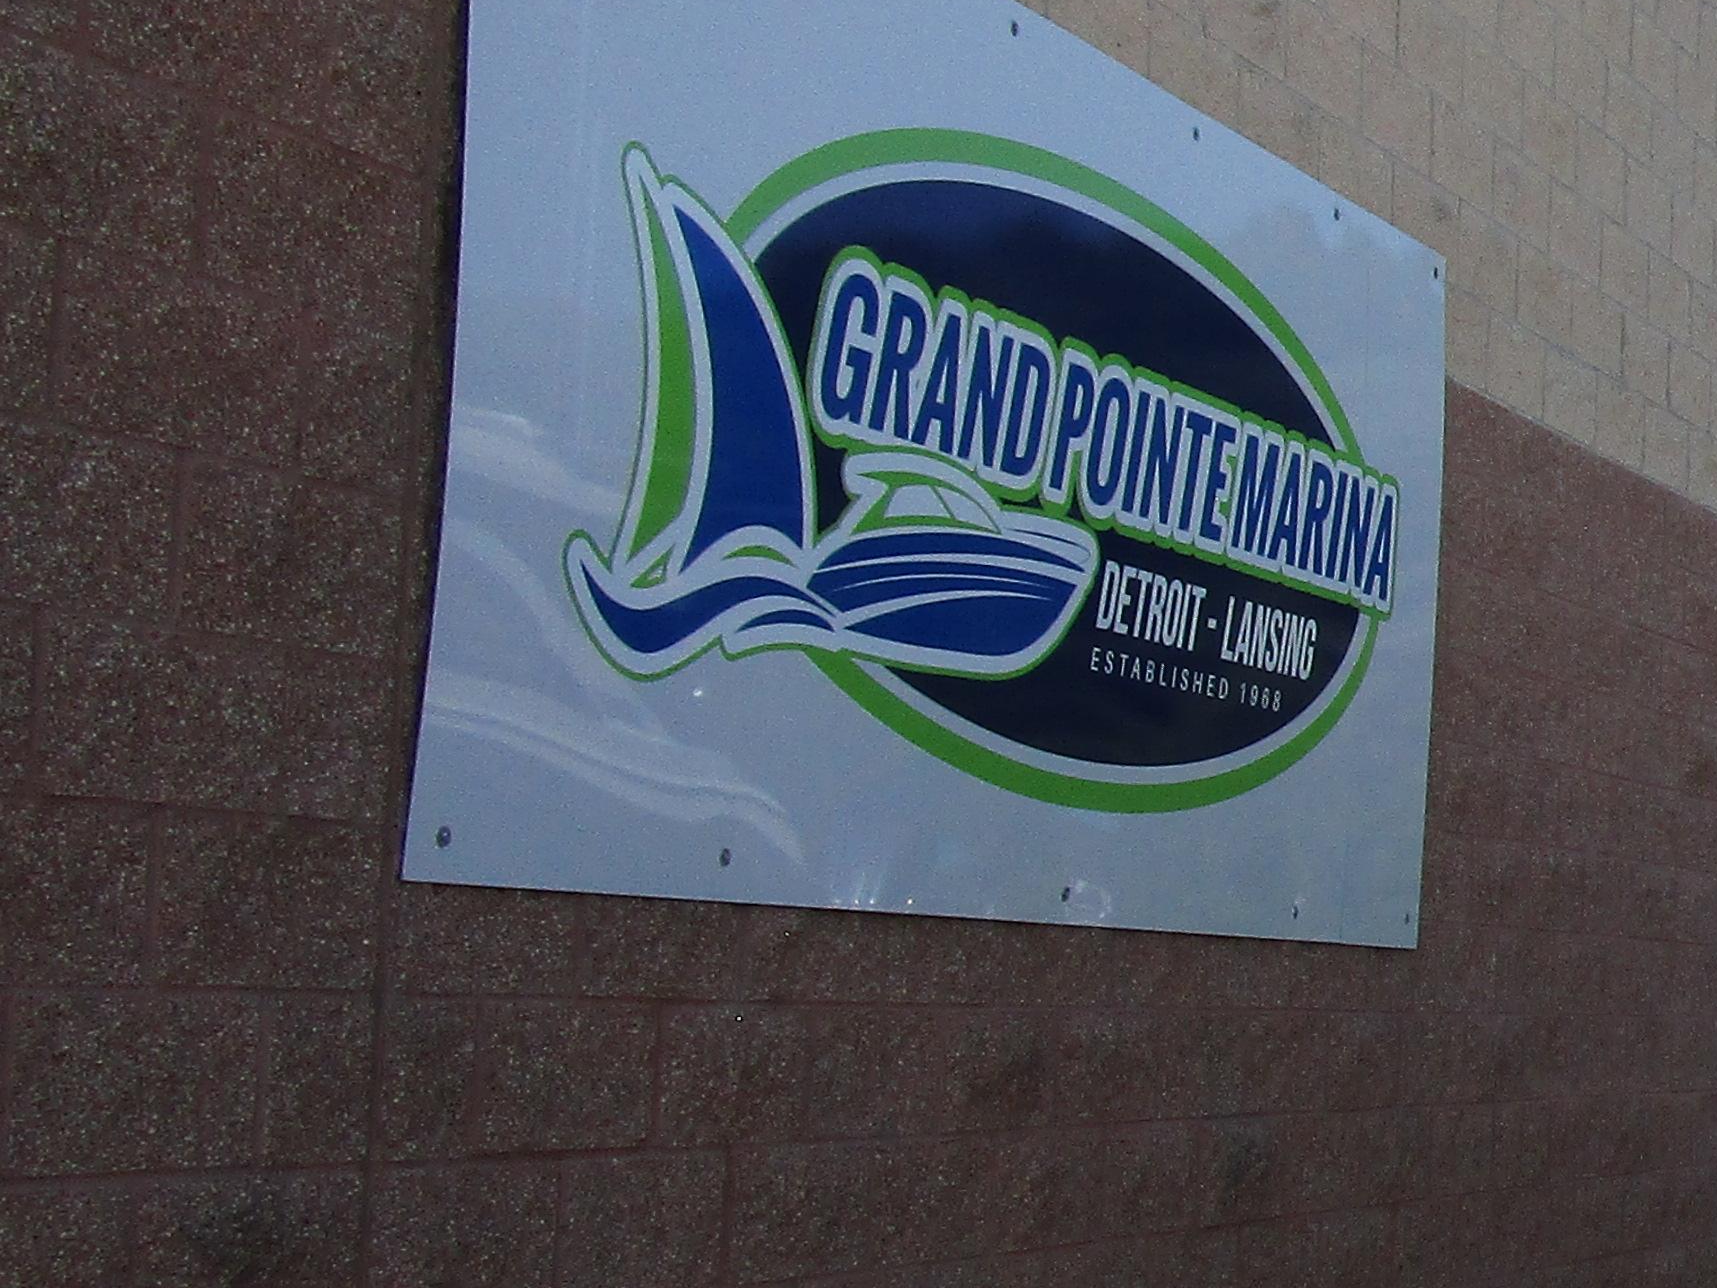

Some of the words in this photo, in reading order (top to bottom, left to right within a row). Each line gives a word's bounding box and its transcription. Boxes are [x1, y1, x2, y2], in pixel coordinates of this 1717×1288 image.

[819, 272, 1052, 478] GRAND
[1047, 361, 1238, 543] POINTE
[1230, 433, 1396, 603] MARINA
[1089, 646, 1230, 700] ESTABLISHED
[1238, 682, 1282, 713] 1968
[1095, 559, 1207, 652] DETROIT
[1220, 595, 1318, 681] LANSING
